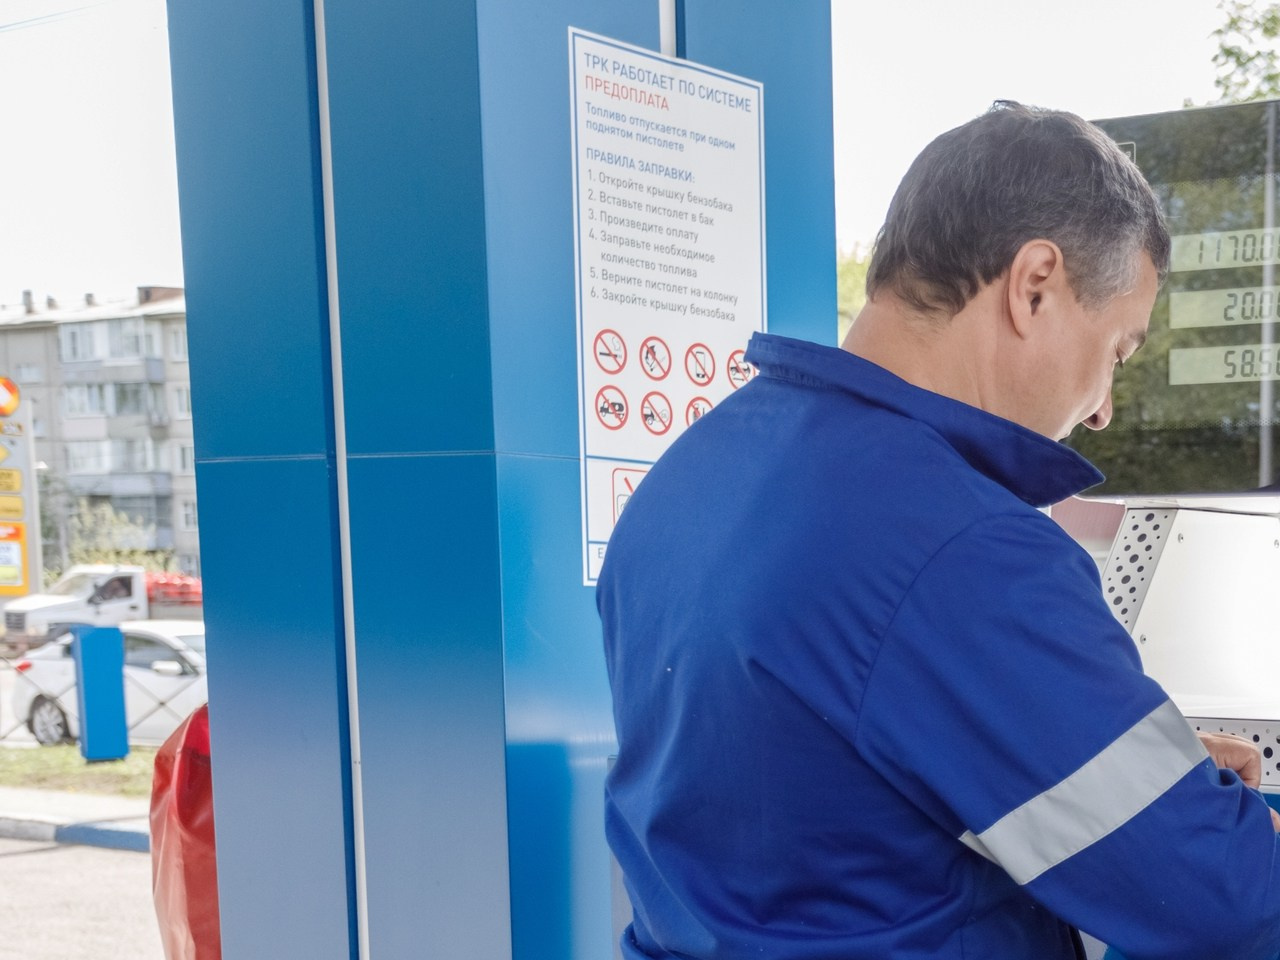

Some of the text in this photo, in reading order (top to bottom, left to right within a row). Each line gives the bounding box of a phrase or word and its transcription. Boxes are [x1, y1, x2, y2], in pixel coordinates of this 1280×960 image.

[584, 52, 752, 112] ТРК РАБОТАЕТ ПО СИСТЕМЕ
[585, 75, 669, 111] ПРЕДОПЛАТА
[585, 102, 736, 151] Топливо отпускается при одном
[586, 120, 684, 152] поднятом пистолете
[586, 147, 696, 183] ПРАВИЛА ЗАПРАВКИ:
[588, 169, 734, 213] 1. Откройте крышку бензобака
[588, 188, 715, 226] 2. Вставьте пистолет в бак
[588, 208, 699, 243] 3. Произведите оплату
[588, 228, 716, 264] 4. Заправьте необходимое
[600, 252, 698, 278] количество топлива
[589, 267, 739, 307] 5. Верните пистолет на колонку
[590, 286, 736, 322] 6. Закройте крышку бензобака
